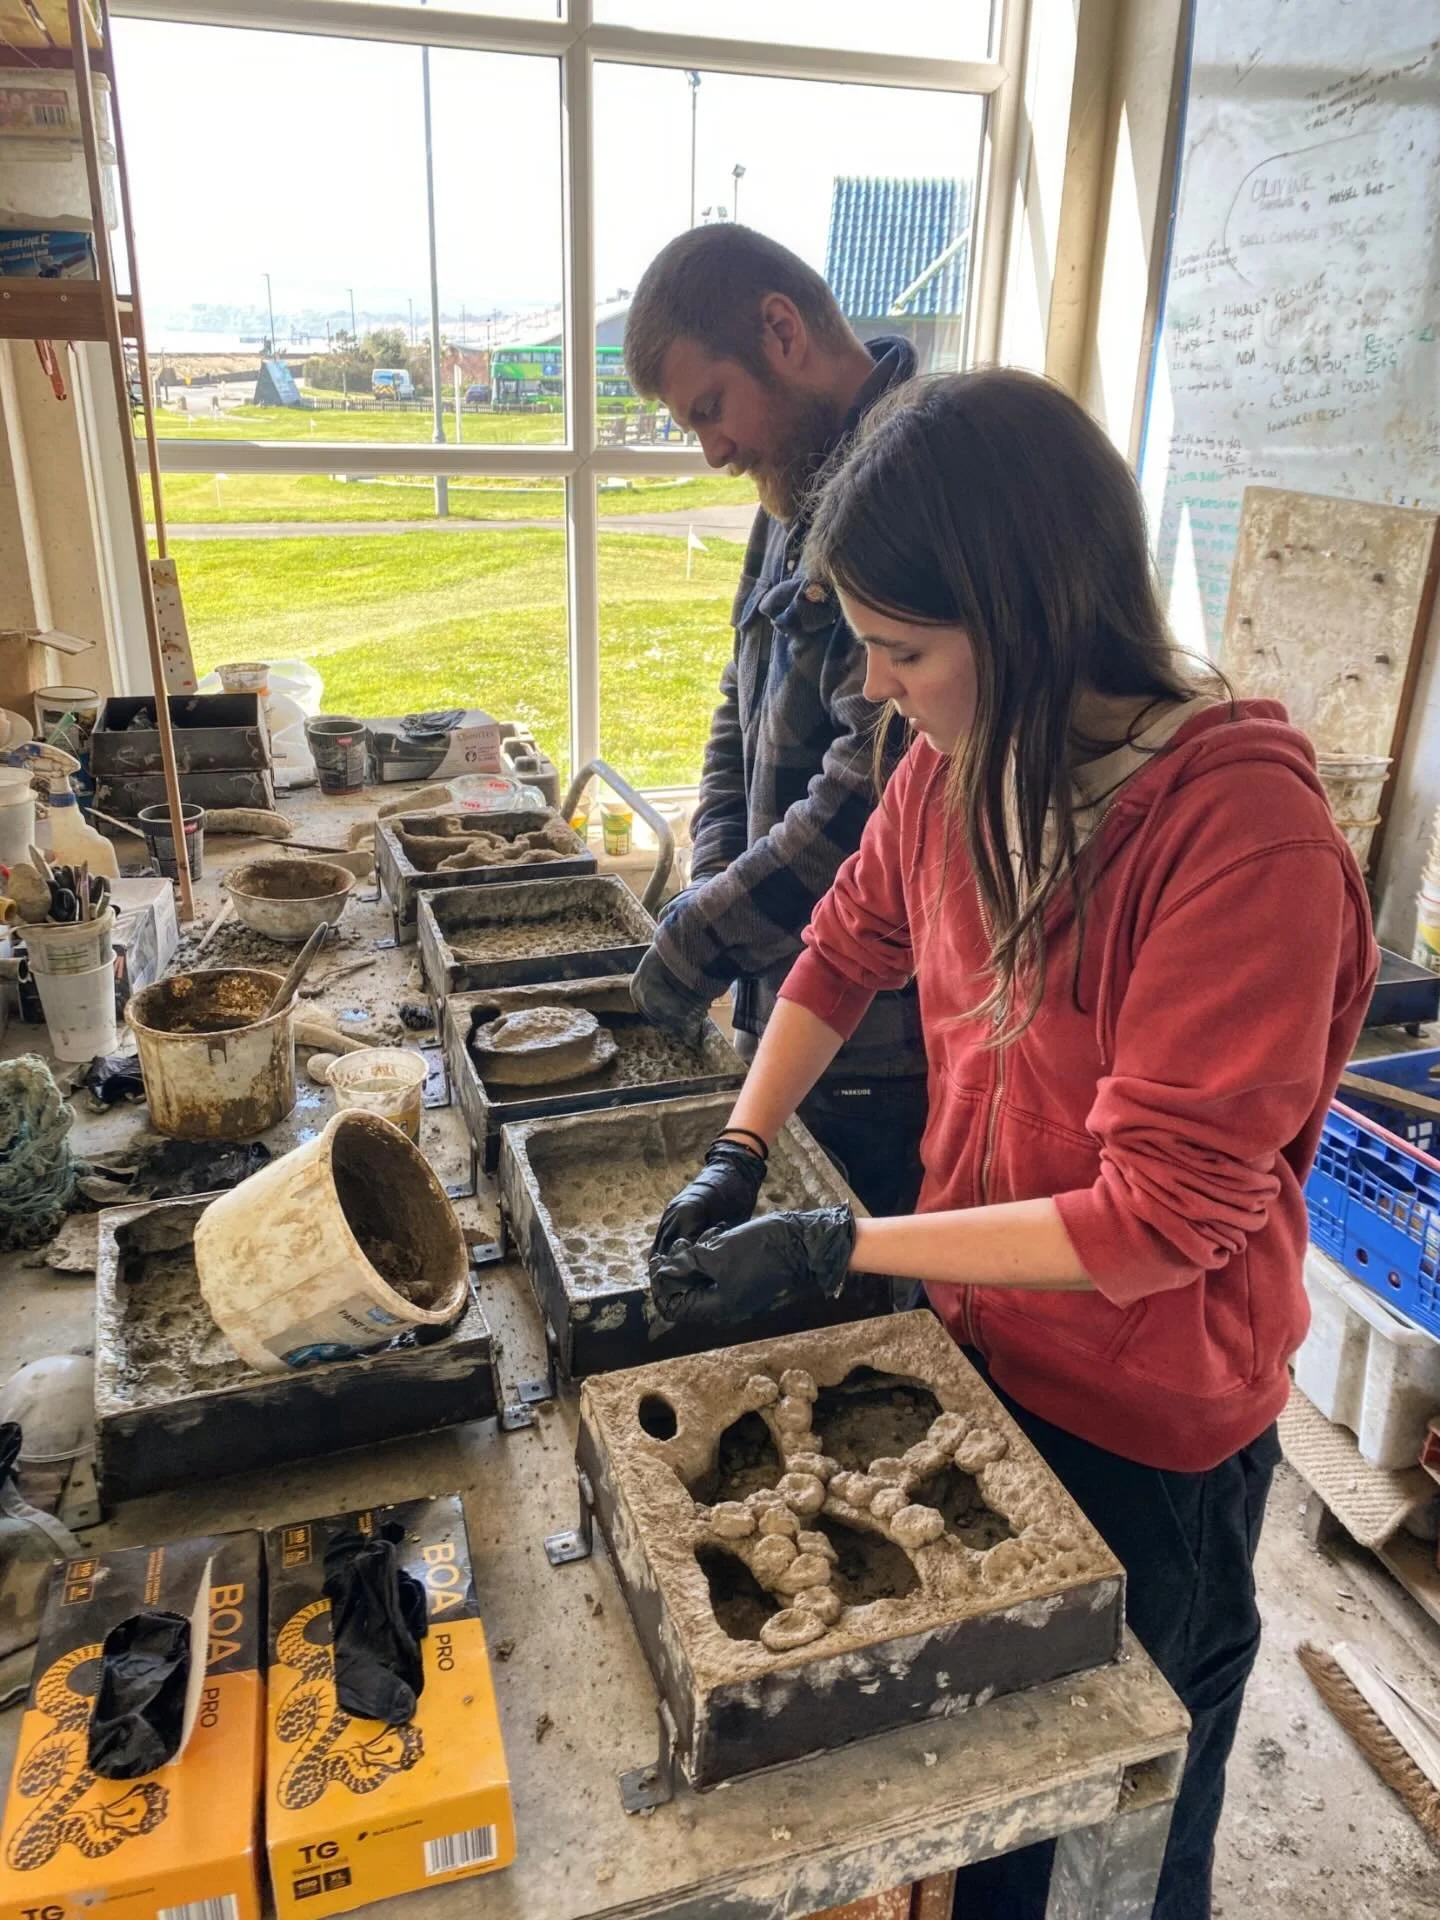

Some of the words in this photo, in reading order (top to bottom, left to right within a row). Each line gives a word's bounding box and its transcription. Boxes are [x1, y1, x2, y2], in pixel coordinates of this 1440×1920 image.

[422, 1542, 466, 1616] BOA
[208, 1583, 245, 1667] BOA
[435, 1633, 454, 1672] PRO
[201, 1687, 220, 1729] PRO
[298, 1841, 340, 1864] TG
[20, 1905, 65, 1920] TG
